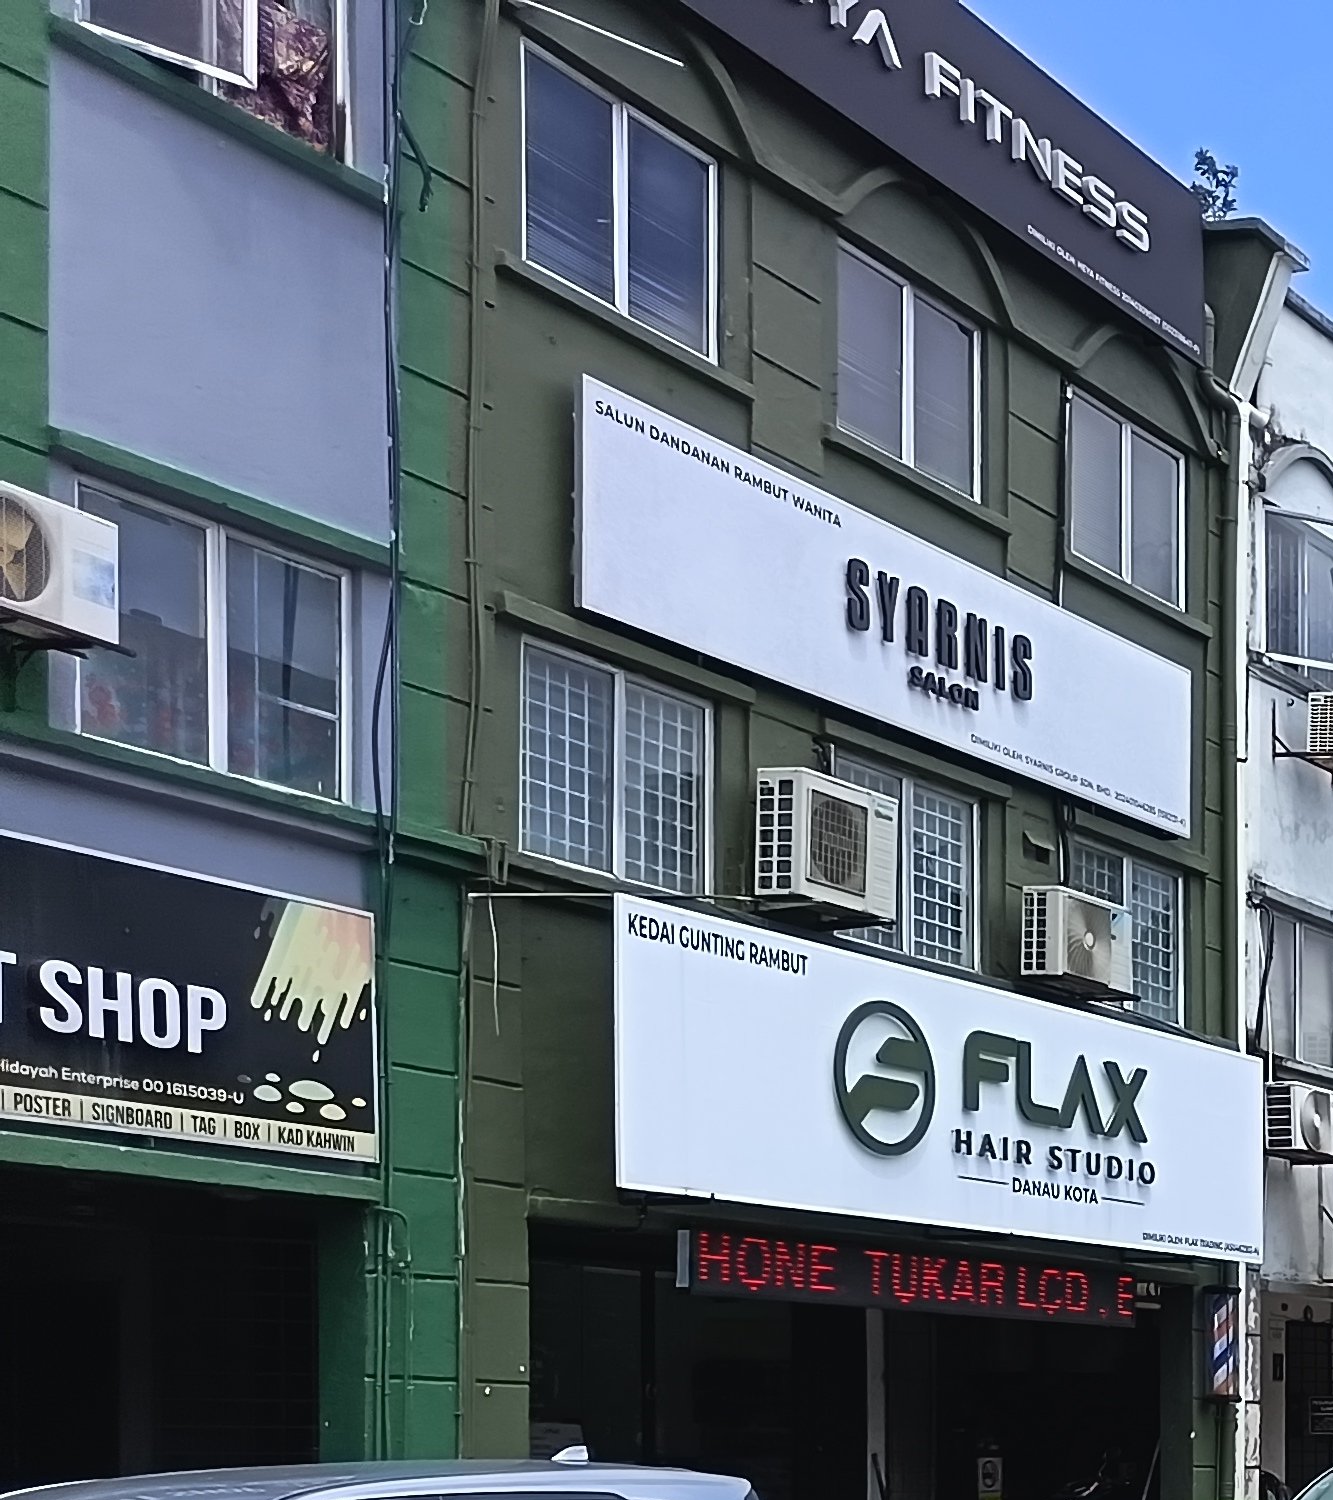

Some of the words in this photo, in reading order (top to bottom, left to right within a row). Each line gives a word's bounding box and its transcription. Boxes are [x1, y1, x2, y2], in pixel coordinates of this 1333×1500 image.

[924, 51, 1150, 253] FITNESS
[594, 400, 645, 434] SALUN
[649, 424, 730, 474] DANDANAN
[734, 465, 789, 502] RAMBUT
[792, 493, 842, 528] WANITA
[846, 558, 1033, 701] SYARNIS
[907, 665, 980, 711] SALON
[628, 912, 676, 945] KEDAI
[679, 925, 745, 961] GUNTING
[749, 941, 809, 976] RAMBUT
[39, 959, 228, 1054] SHOP
[61, 1066, 140, 1092] Enterprise
[962, 1029, 1149, 1144] FLAX
[13, 1092, 72, 1118] POSTER
[91, 1102, 173, 1130] SIGNBOARD
[190, 1115, 217, 1136] TAG
[233, 1121, 261, 1141] BOX
[277, 1126, 304, 1146] KAD
[305, 1127, 356, 1153] KAHWIN
[952, 1128, 1033, 1166] HAIR
[1047, 1145, 1157, 1185] STUDIO
[1012, 1176, 1061, 1200] DANAU
[1064, 1184, 1100, 1205] KOTA
[698, 1231, 838, 1292] HONE
[863, 1249, 1006, 1304] TUKAR
